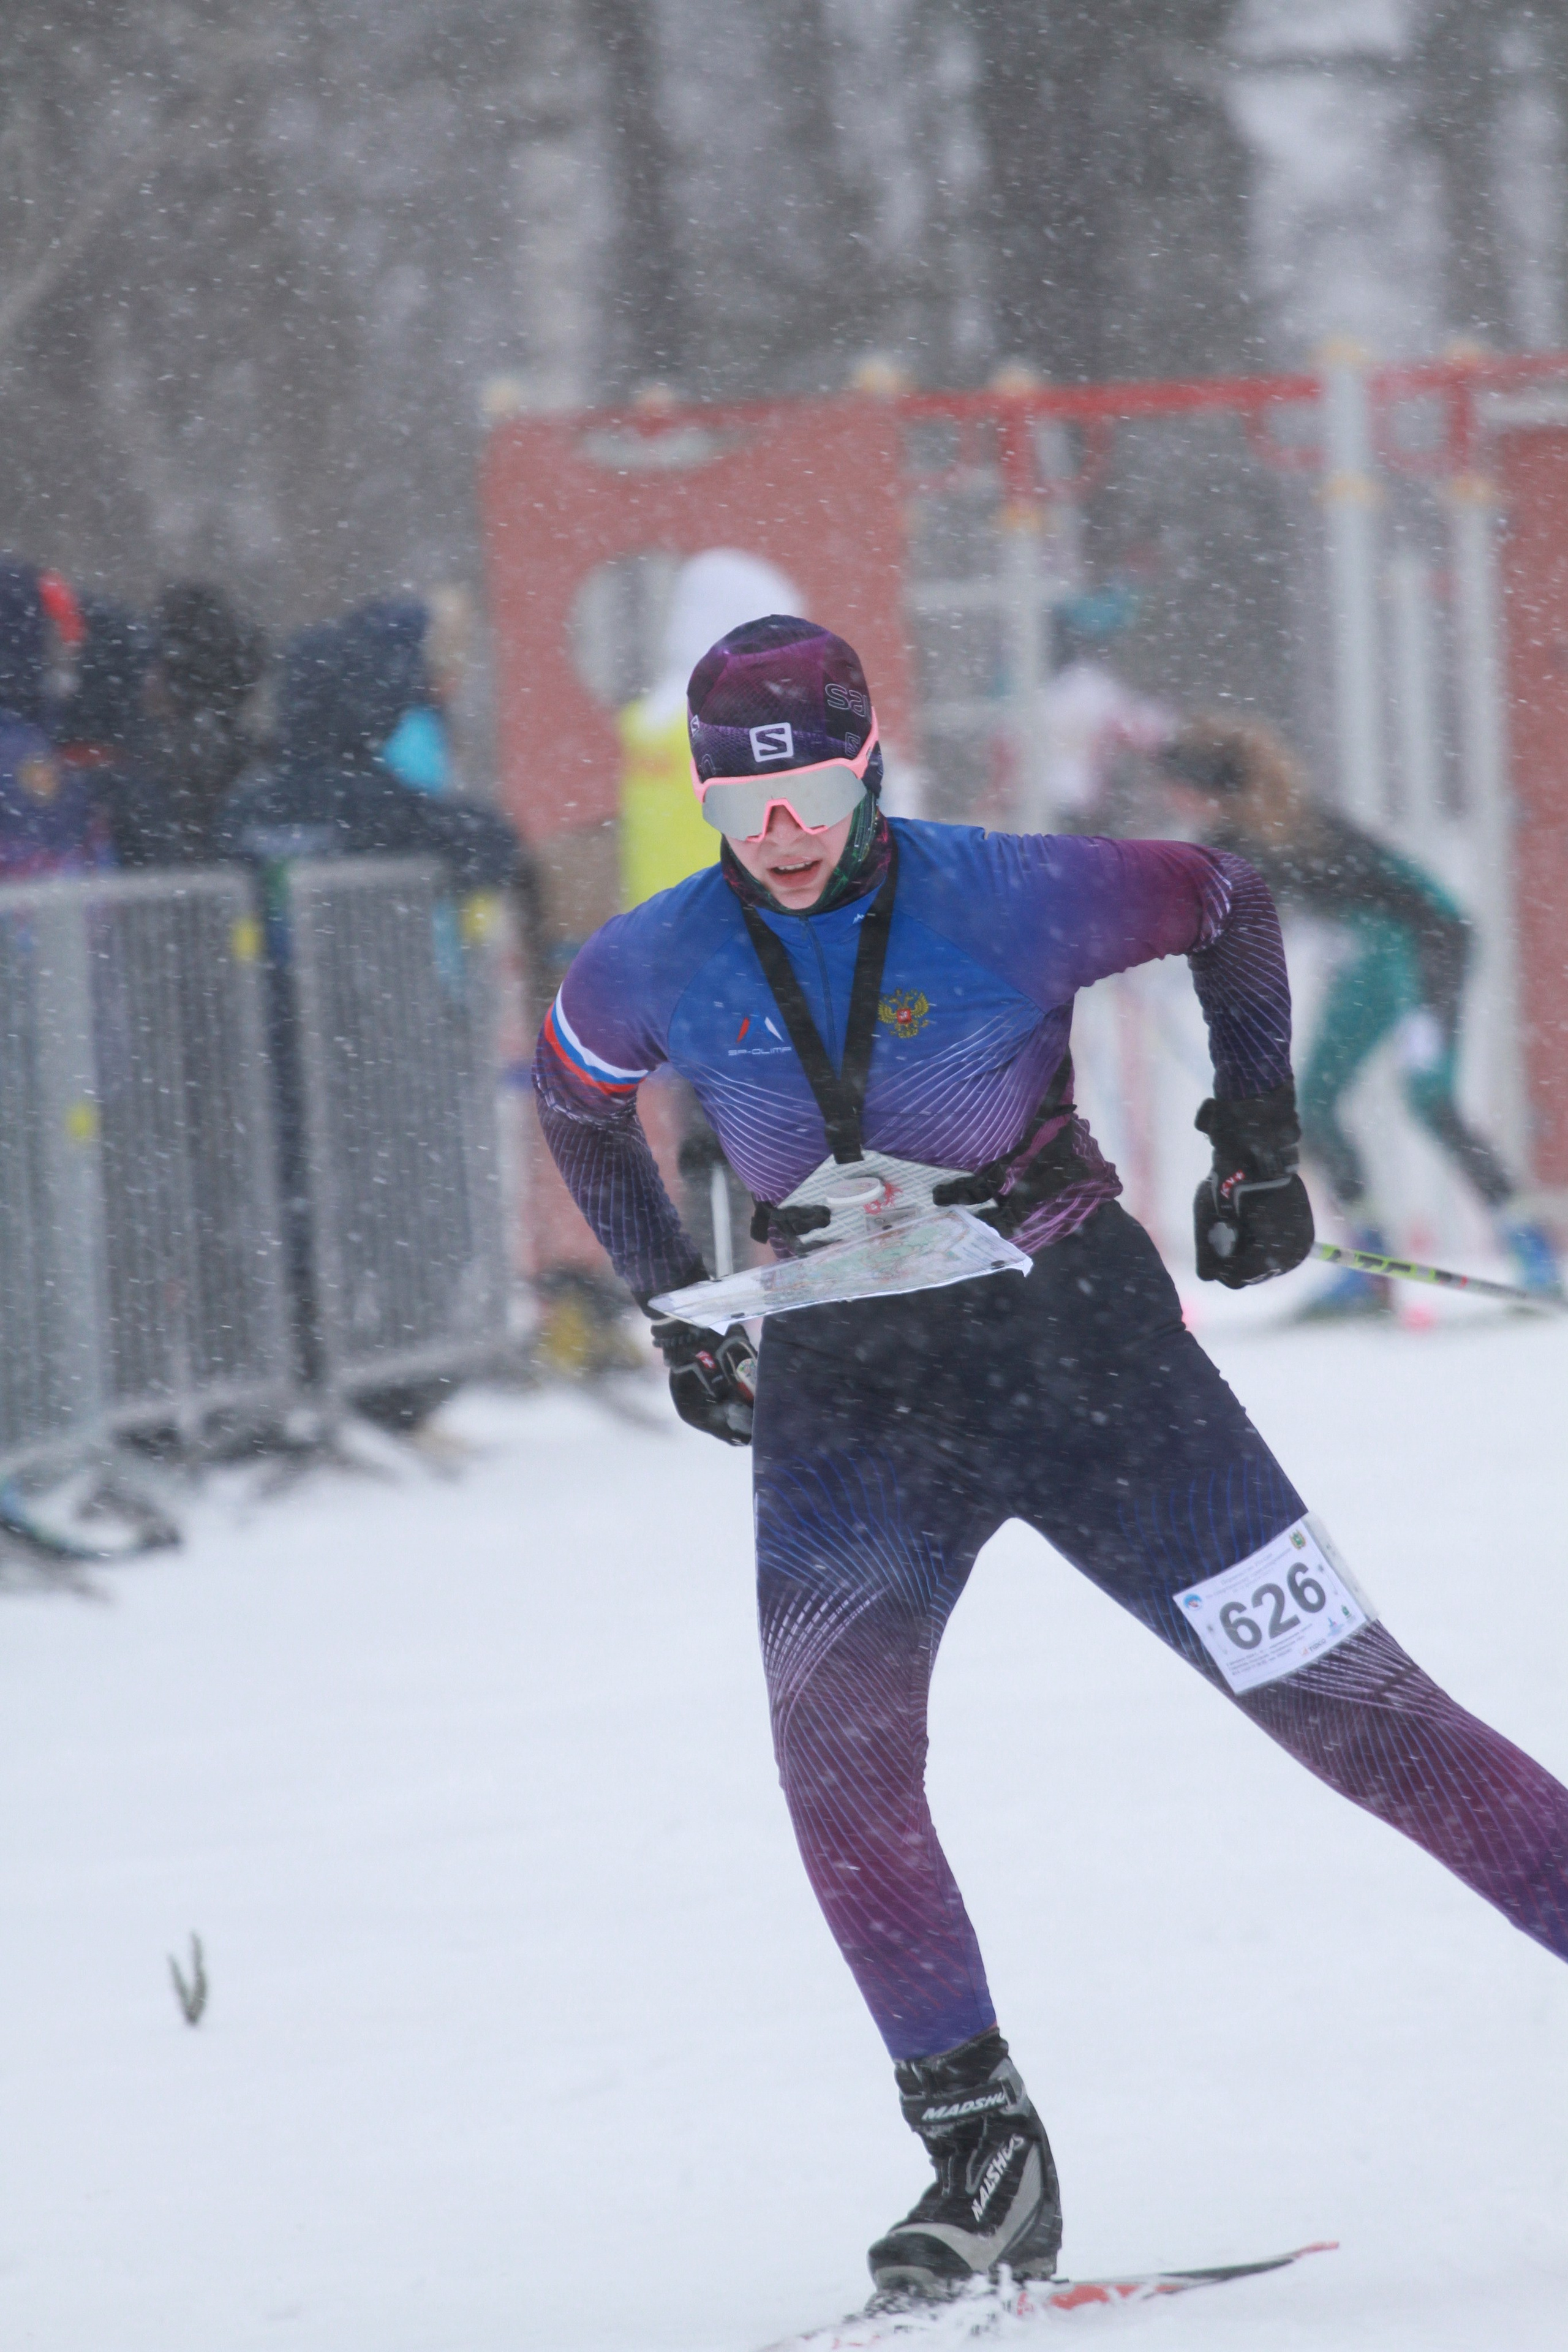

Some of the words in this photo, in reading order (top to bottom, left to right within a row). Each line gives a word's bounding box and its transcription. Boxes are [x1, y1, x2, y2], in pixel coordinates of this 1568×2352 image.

[824, 683, 869, 719] sa
[728, 1046, 792, 1056] SP-OLIMP
[1219, 1561, 1326, 1650] 626
[971, 2133, 1025, 2222] MADSHUS
